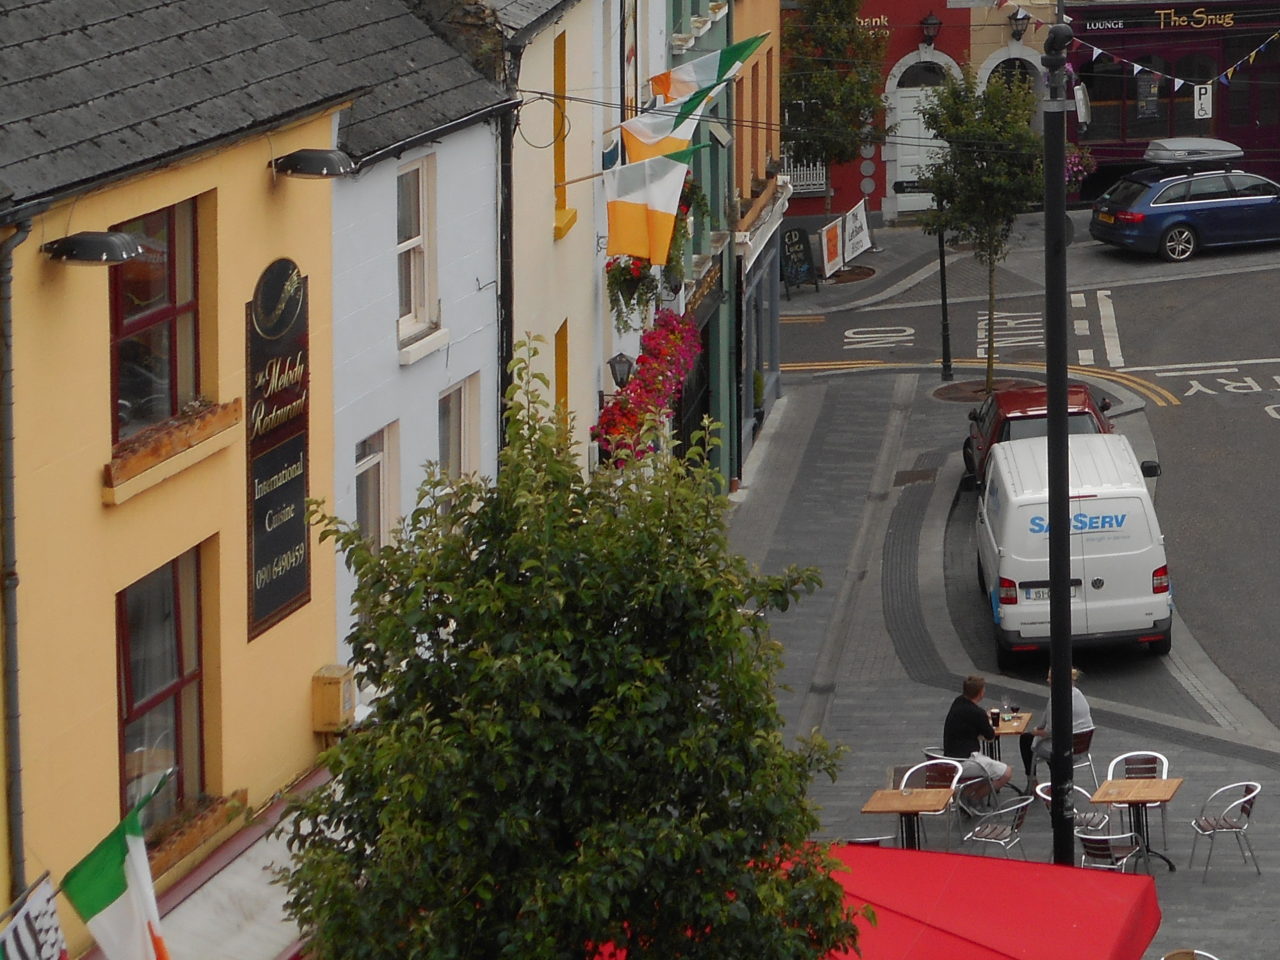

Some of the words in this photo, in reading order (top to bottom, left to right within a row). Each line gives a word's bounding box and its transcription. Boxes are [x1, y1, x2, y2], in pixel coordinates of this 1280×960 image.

[1086, 20, 1124, 30] LOUNGE
[1155, 9, 1187, 29] The
[1190, 7, 1235, 28] Snug
[1198, 86, 1208, 101] P
[263, 351, 305, 398] Melody
[251, 389, 307, 440] Restaurant
[254, 452, 304, 500] International
[265, 503, 295, 531] Cuisine
[256, 563, 271, 590] 090
